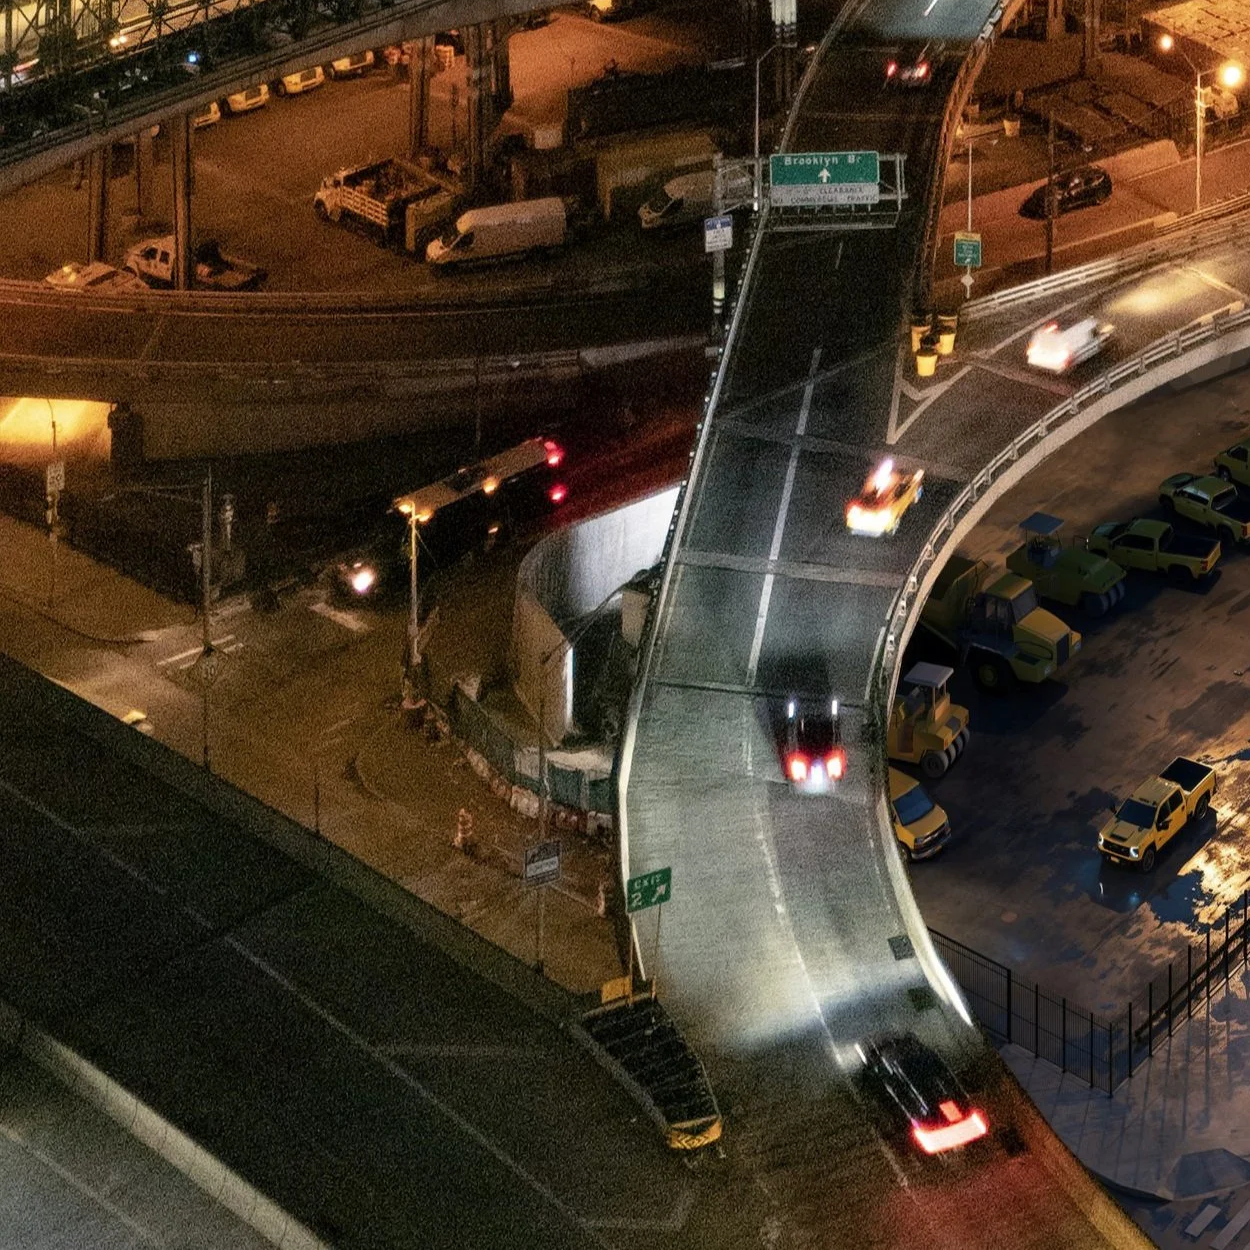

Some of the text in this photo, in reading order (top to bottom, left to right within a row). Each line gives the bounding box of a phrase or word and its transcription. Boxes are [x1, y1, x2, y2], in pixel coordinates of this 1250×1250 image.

[784, 156, 838, 167] Brooklyn
[634, 874, 662, 889] EXIT
[631, 892, 642, 907] 2
